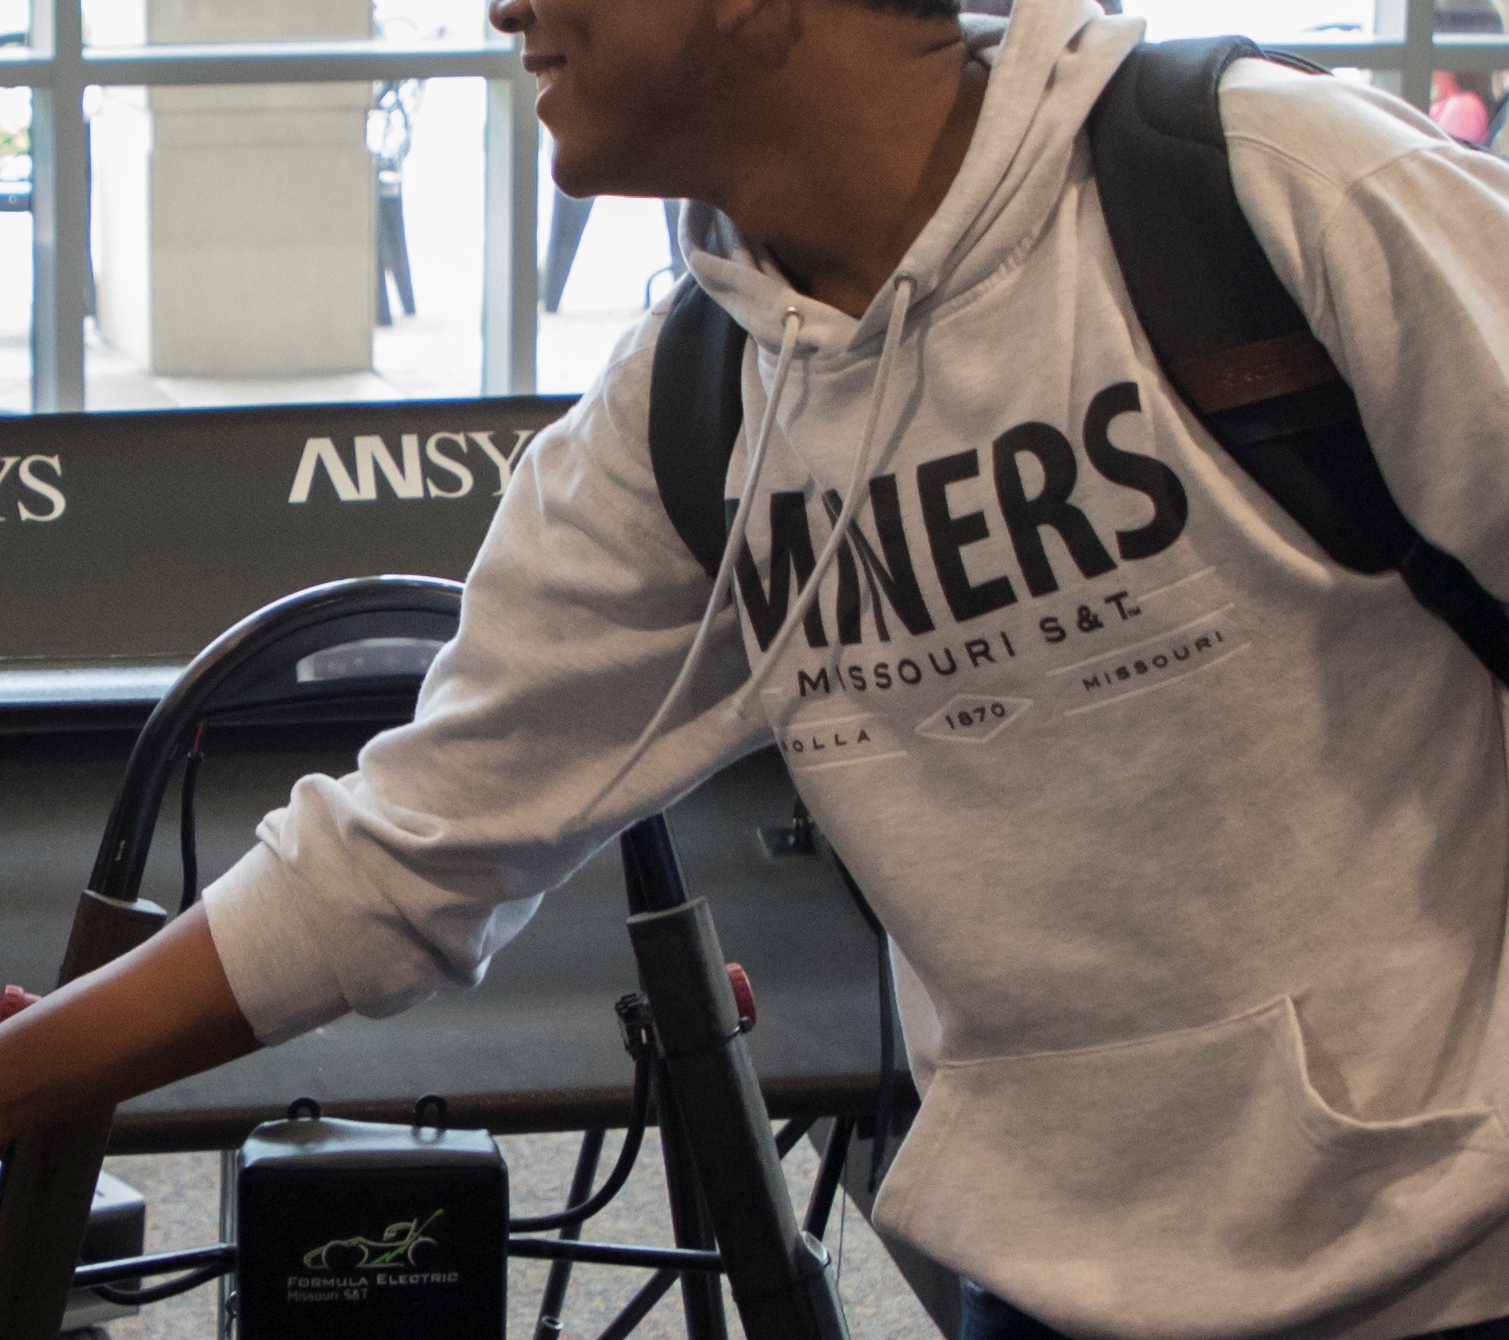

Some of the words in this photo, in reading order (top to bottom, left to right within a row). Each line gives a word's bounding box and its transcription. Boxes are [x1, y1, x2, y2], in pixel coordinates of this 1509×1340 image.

[289, 430, 535, 504] ANSY
[724, 381, 1188, 653] MINERS
[797, 631, 1016, 697] MISSOURI
[1082, 630, 1226, 691] MISSOURI
[945, 702, 1006, 730] 1870
